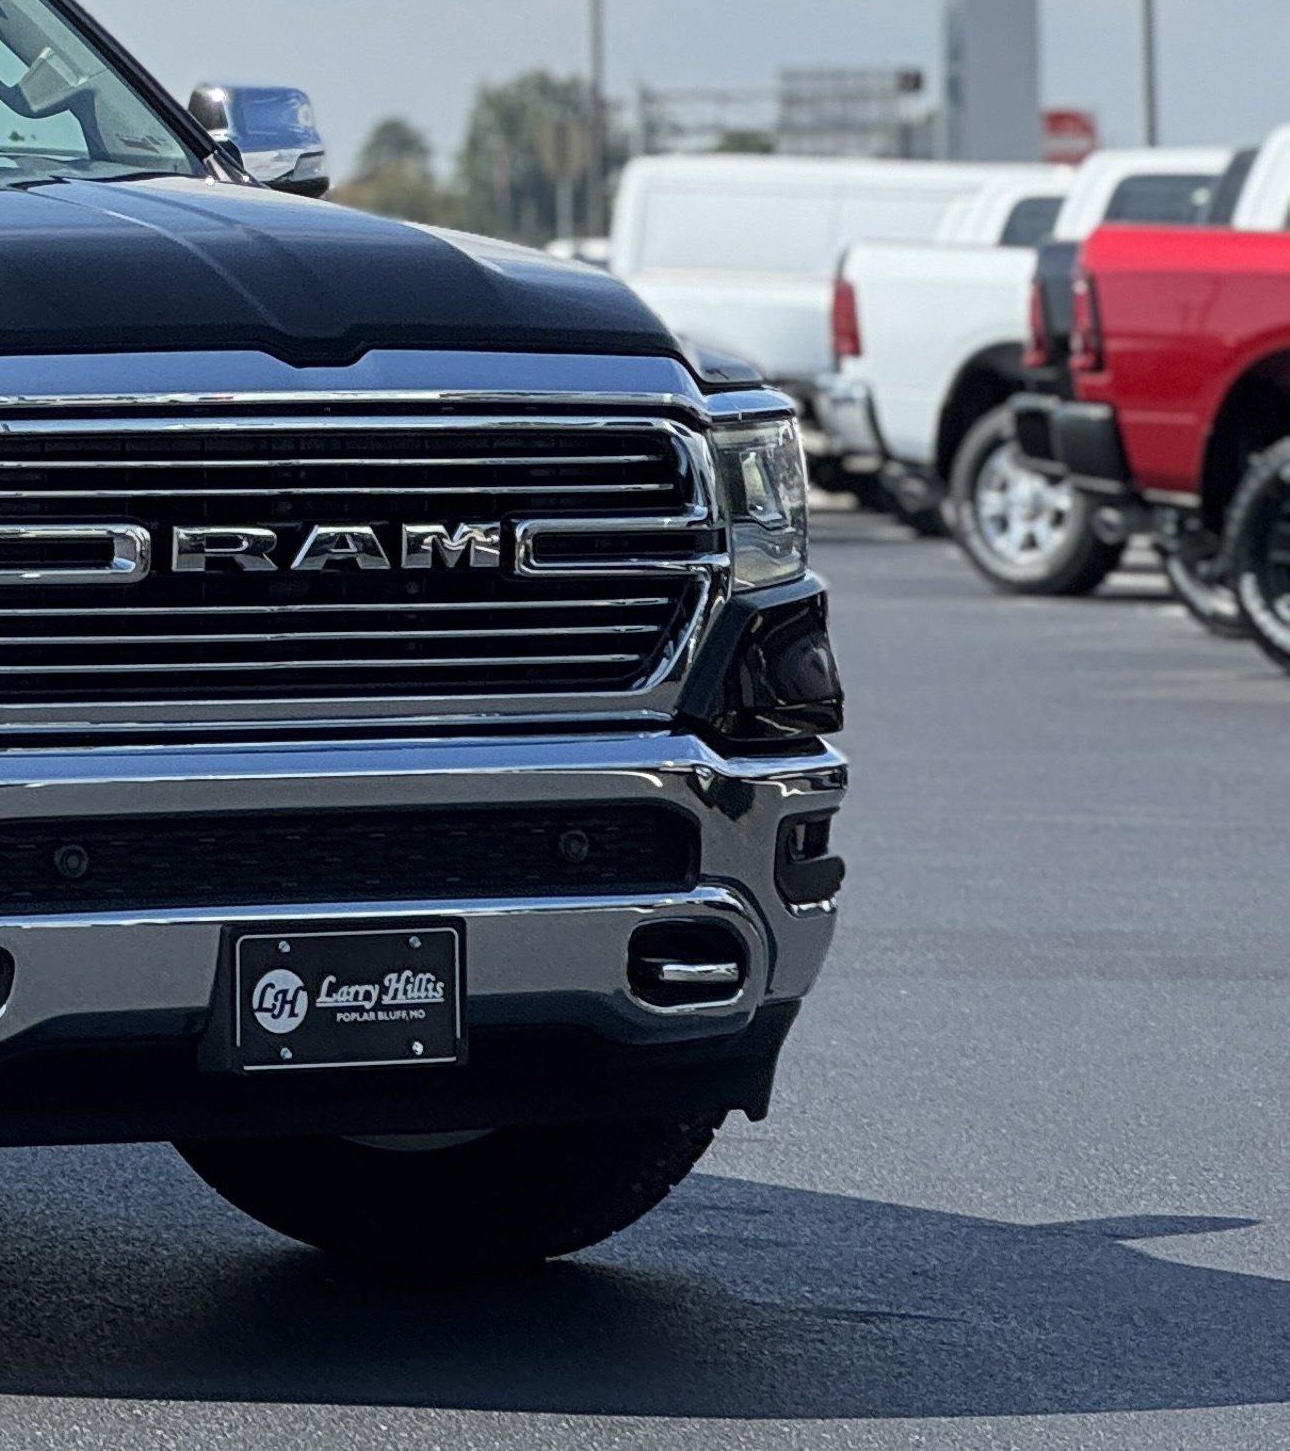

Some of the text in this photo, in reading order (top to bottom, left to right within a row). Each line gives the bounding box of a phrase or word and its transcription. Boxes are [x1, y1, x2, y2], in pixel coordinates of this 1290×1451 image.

[171, 523, 501, 571] RAM
[316, 970, 445, 1009] Larry Hillis
[336, 1011, 376, 1022] POPLAR
